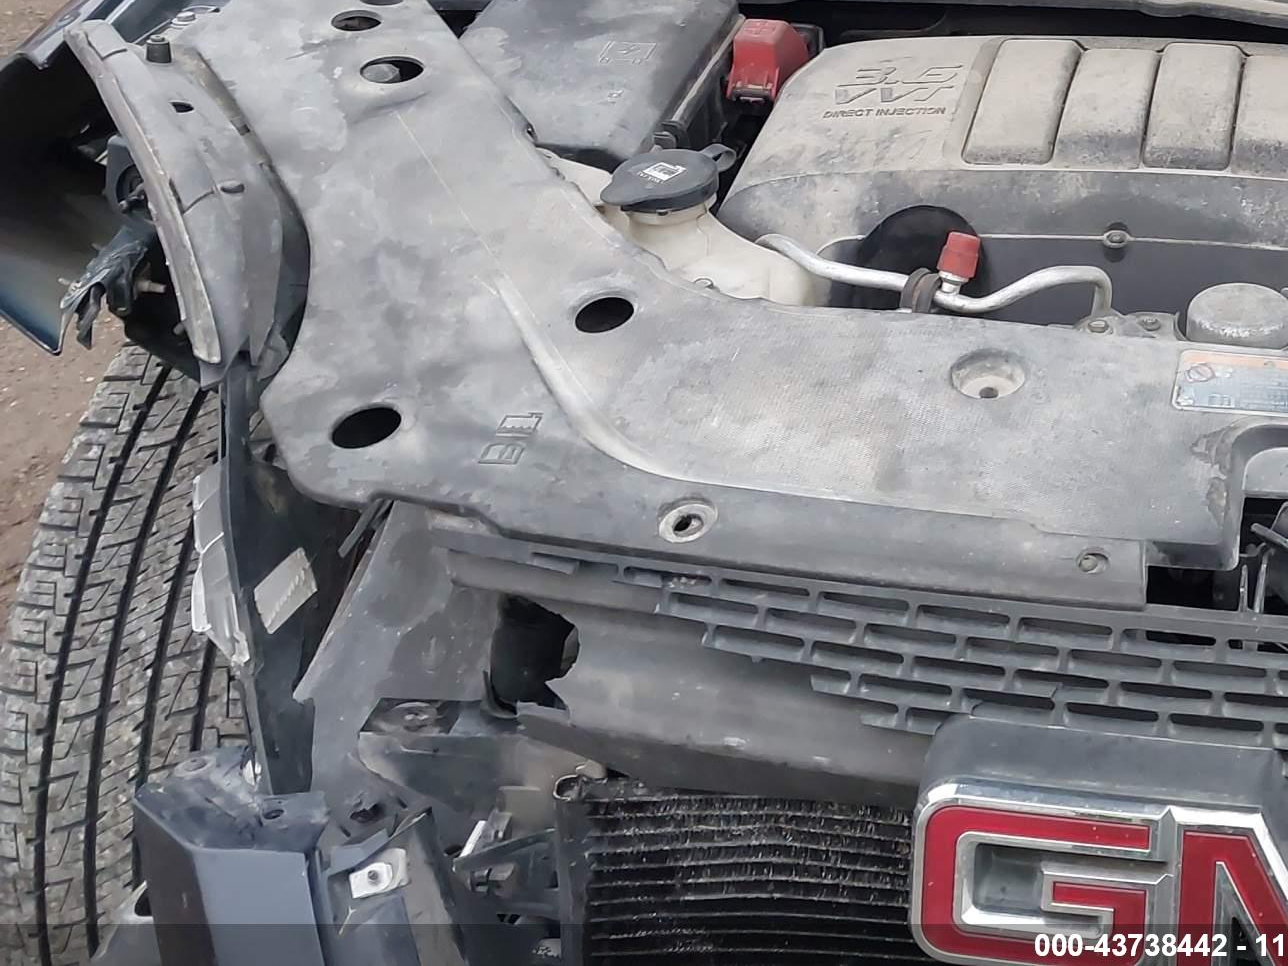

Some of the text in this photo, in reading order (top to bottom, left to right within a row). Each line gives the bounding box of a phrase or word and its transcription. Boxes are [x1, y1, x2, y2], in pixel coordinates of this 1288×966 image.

[837, 65, 964, 87] 3.6
[834, 85, 956, 105] VVT
[822, 106, 947, 119] DIRECT INJECTION
